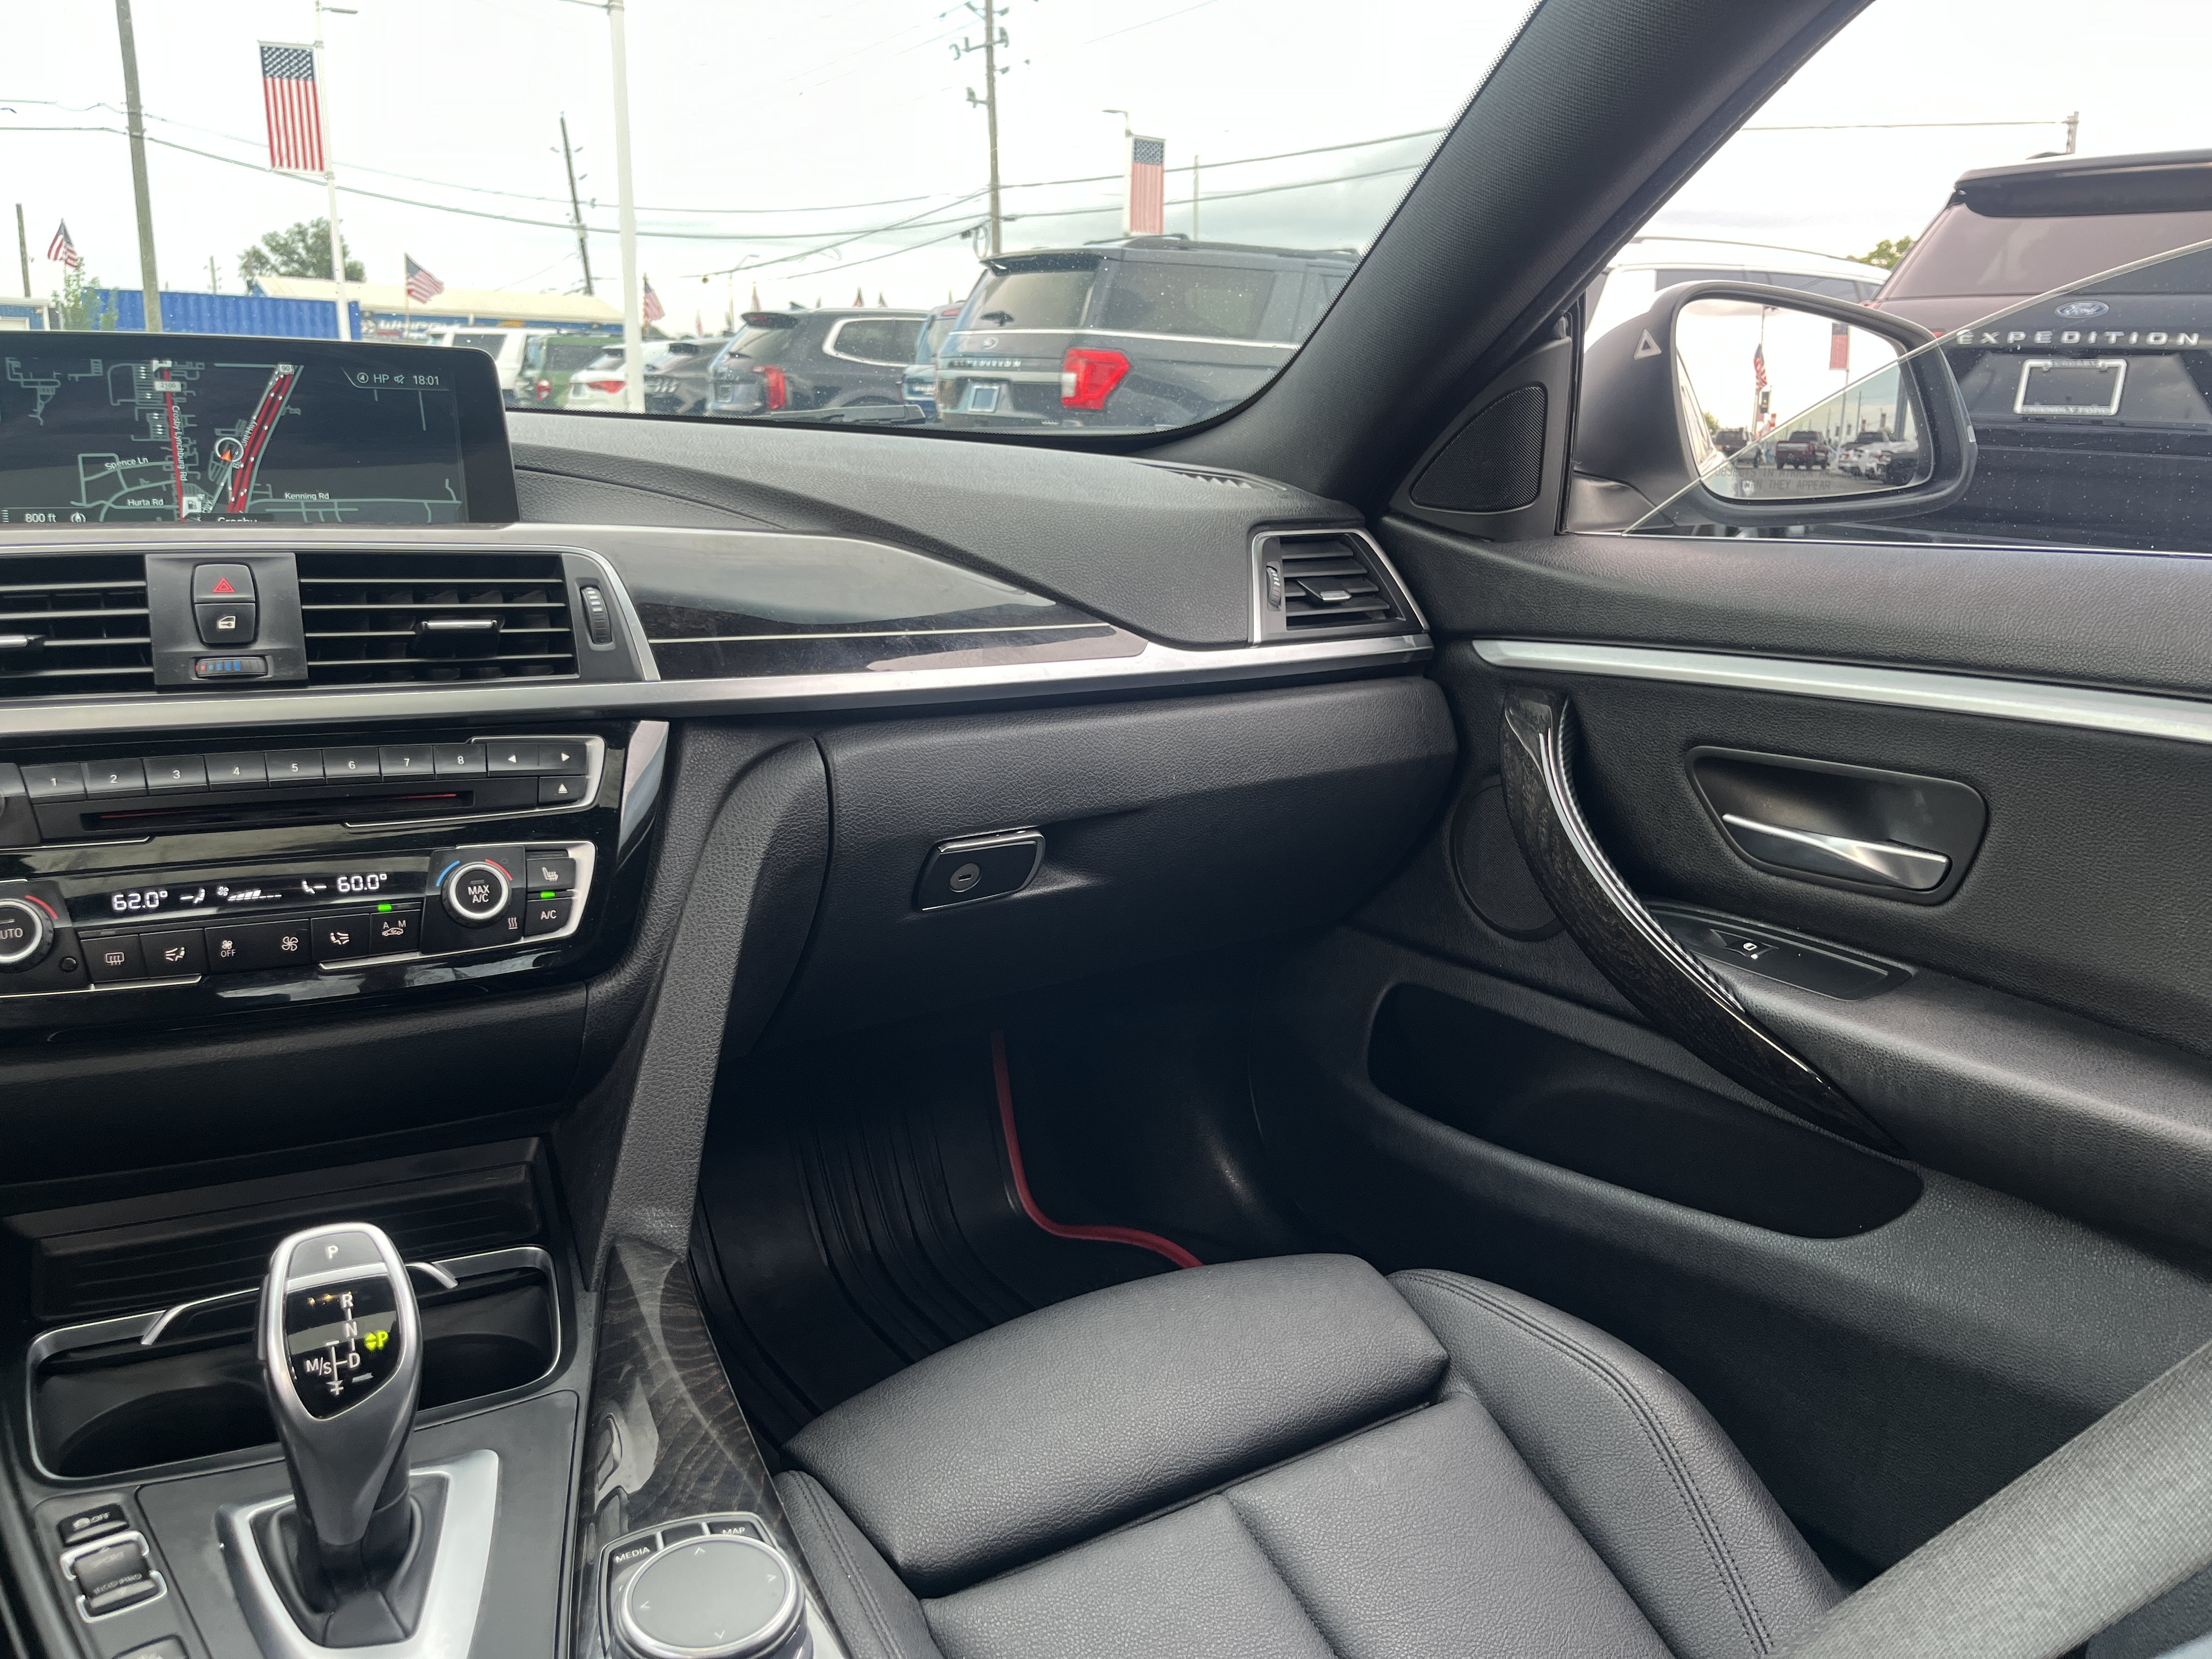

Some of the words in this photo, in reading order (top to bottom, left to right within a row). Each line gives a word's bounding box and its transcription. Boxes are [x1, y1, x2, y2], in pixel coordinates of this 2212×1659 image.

[1956, 330, 2200, 346] EXPEDITION
[374, 374, 390, 383] HP
[413, 375, 439, 386] 18:01
[172, 405, 182, 431] Crosby
[174, 432, 185, 469] Lynchburg
[105, 458, 136, 470] Spence
[180, 471, 188, 482] Rd
[1768, 479, 1792, 489] THEY
[1797, 479, 1831, 490] APPEAR
[285, 492, 317, 501] Kenning
[25, 513, 46, 523] 800
[47, 513, 57, 522] ft
[348, 760, 356, 770] 6
[403, 758, 410, 767] 7
[456, 755, 465, 765] 8
[233, 766, 240, 776] 4
[291, 763, 299, 772] 5
[110, 774, 118, 784] 2
[173, 770, 180, 779] 3
[50, 777, 57, 787] 1
[468, 885, 490, 896] MAX
[472, 894, 489, 904] A/C
[540, 909, 557, 921] A/C
[398, 919, 407, 928] M
[0, 928, 24, 940] UTO
[221, 949, 236, 958] OFF
[326, 1245, 338, 1259] P
[341, 1293, 354, 1308] R
[345, 1321, 358, 1338] N
[376, 1330, 389, 1349] P
[304, 1357, 332, 1376] M/S
[348, 1352, 361, 1369] D
[721, 1526, 746, 1535] MAP
[614, 1546, 651, 1564] MEDIA
